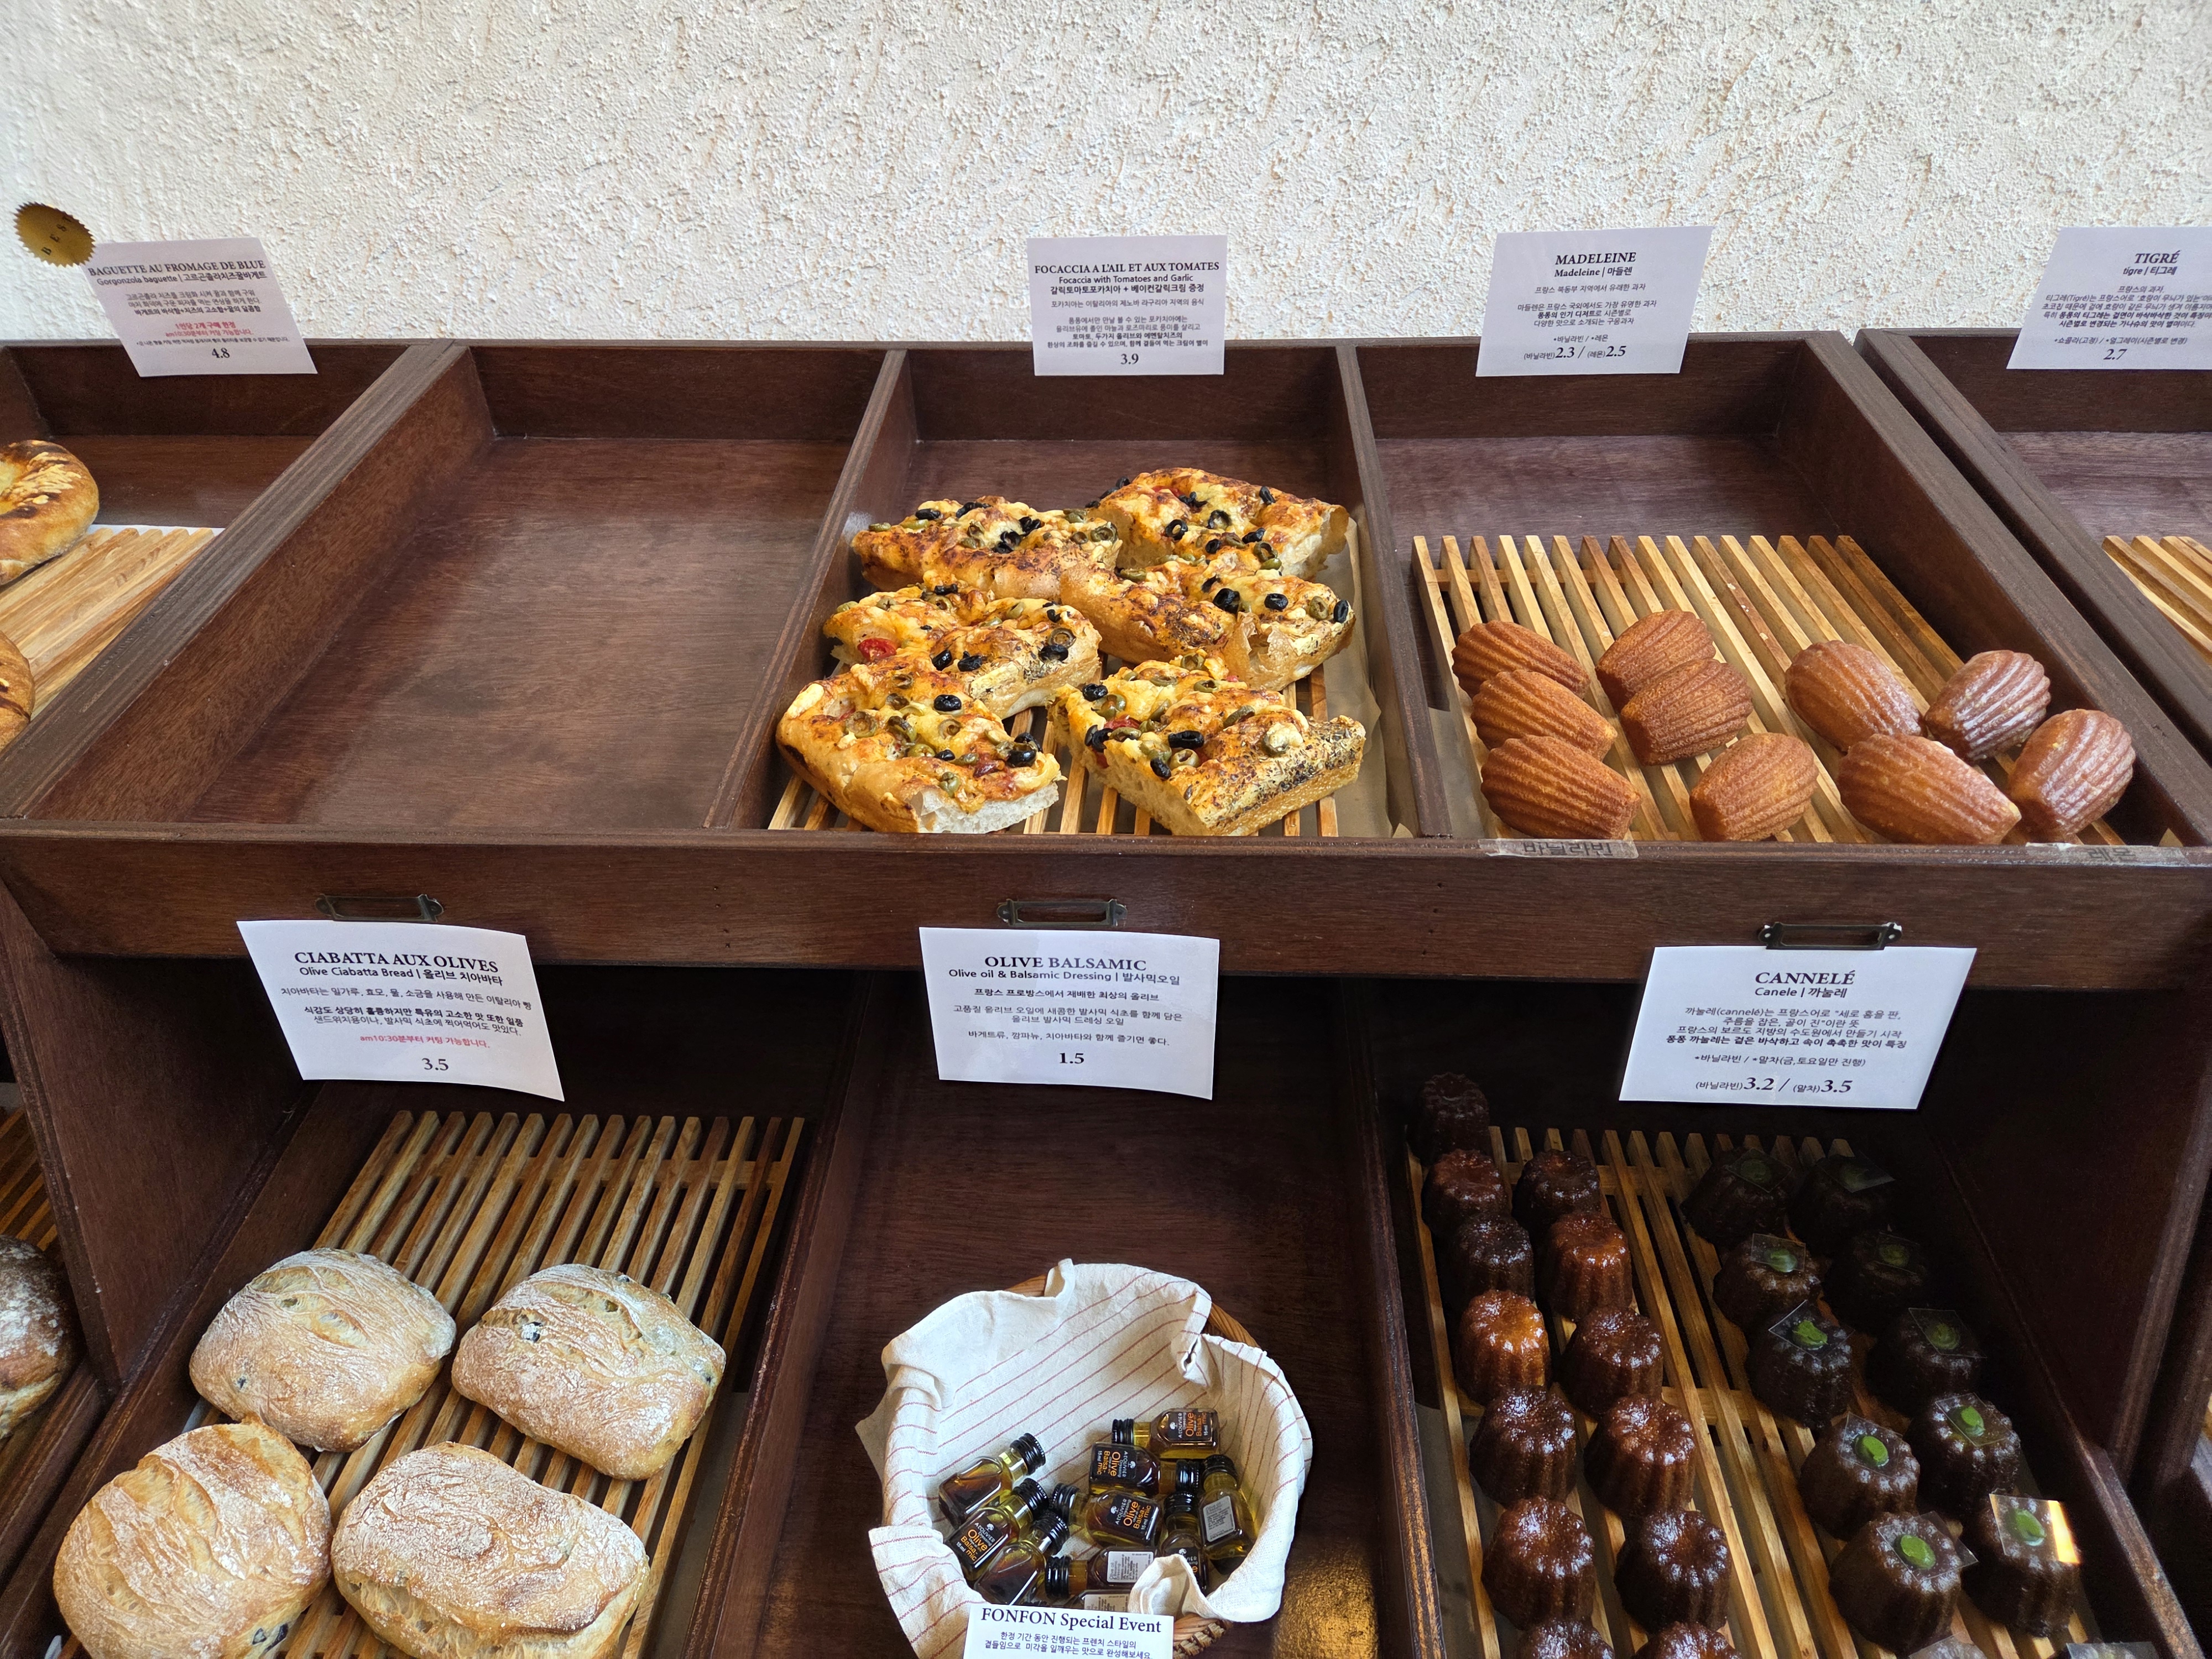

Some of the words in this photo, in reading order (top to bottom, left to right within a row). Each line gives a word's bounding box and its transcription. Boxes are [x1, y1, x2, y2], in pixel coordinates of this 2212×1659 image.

[41, 216, 71, 255] BEST
[1555, 252, 1636, 265] MADELEINE
[2134, 250, 2180, 263] TIGRÉ
[87, 265, 147, 276] BAGUETTE
[149, 264, 163, 272] AU
[164, 262, 218, 272] FROMAGE
[219, 261, 236, 270] DE
[236, 260, 265, 269] BLUE
[1035, 264, 1091, 273] FOCACCIA
[1128, 263, 1141, 272] ET
[1144, 263, 1166, 271] AUX
[1168, 262, 1219, 270] TOMATES
[1554, 268, 1600, 277] Madeleine
[1607, 266, 1632, 276] 마들렌
[2122, 267, 2143, 275] tigre
[2150, 266, 2178, 275] 티그레
[96, 276, 142, 285] Gorgonzola
[1059, 275, 1091, 284] Focaccia
[1170, 273, 1193, 281] Garlic
[1050, 285, 1120, 295] 갈릭토마토포카치아
[1131, 284, 1186, 293] 베이컨갈릭크림
[1188, 283, 1204, 292] 증정
[1579, 284, 1607, 293] 지역에서
[1609, 283, 1630, 291] 유래한
[1517, 303, 1545, 311] 마들렌은
[1568, 301, 1602, 310] 국외에서도
[1620, 300, 1641, 308] 유명한
[212, 347, 229, 358] 4.8
[1120, 353, 1139, 364] 3.9
[2103, 348, 2127, 359] 2.7
[1522, 841, 1614, 856] 바닐라빈
[294, 952, 390, 964] CIABATTA
[393, 953, 431, 966] AUX
[433, 956, 498, 972] OLIVES
[984, 957, 1043, 967] OLIVE
[1048, 957, 1146, 971] BALSAMIC
[299, 967, 328, 975] Olive
[331, 967, 378, 976] Ciabatta
[380, 968, 414, 977] Bread
[422, 969, 457, 980] 올리브
[460, 972, 502, 985] 치아바타
[948, 969, 977, 977] Olive
[980, 969, 993, 978] oil
[1010, 970, 1059, 979] Balsamic
[1063, 971, 1111, 981] Dressing
[1123, 972, 1179, 985] 발사믹오일
[1755, 969, 1855, 984] CANNELÉ
[1006, 989, 1063, 998] 프로방스에서
[1098, 991, 1126, 999] 최상의
[1130, 992, 1159, 1001] 올리브
[1755, 987, 1797, 996] Canele
[1807, 987, 1847, 998] 까눌레
[953, 1005, 980, 1013] 고품질
[984, 1005, 1013, 1014] 올리브
[1016, 1006, 1044, 1015] 오일에
[1047, 1007, 1076, 1015] 새콤한
[1078, 1008, 1106, 1018] 발사믹
[1108, 1009, 1138, 1019] 식초를
[1142, 1011, 1160, 1019] 함께
[1164, 1012, 1182, 1021] 담은
[1676, 1026, 1718, 1034] 프랑스의
[1719, 1026, 1751, 1036] 보르도
[1755, 1027, 1787, 1036] 지방의
[1790, 1028, 1842, 1037] 수도원에서
[1845, 1029, 1877, 1038] 만들기
[1880, 1030, 1902, 1039] 시작
[1060, 1052, 1084, 1063] 1.5
[421, 1058, 448, 1071] 3.5
[1185, 1412, 1195, 1437] Olive
[1110, 1451, 1121, 1477] Olive
[1123, 1501, 1139, 1526] Olive
[968, 1529, 988, 1551] Olive
[981, 1608, 1056, 1625] FONFON
[1060, 1613, 1113, 1629] Special
[1118, 1617, 1161, 1632] Event
[1000, 1631, 1015, 1640] 한정
[1017, 1632, 1032, 1641] 기간
[1033, 1634, 1048, 1642] 동안
[1051, 1635, 1080, 1645] 진행되는
[1082, 1637, 1104, 1646] 프렌치
[1107, 1640, 1136, 1648] 스타일의
[985, 1640, 1020, 1649] 곁들임으로
[1025, 1643, 1047, 1652] 미각을
[1050, 1644, 1079, 1655] 일깨우는
[1082, 1647, 1104, 1655] 맛으로
[1106, 1648, 1152, 1659] 완성해보세요.
